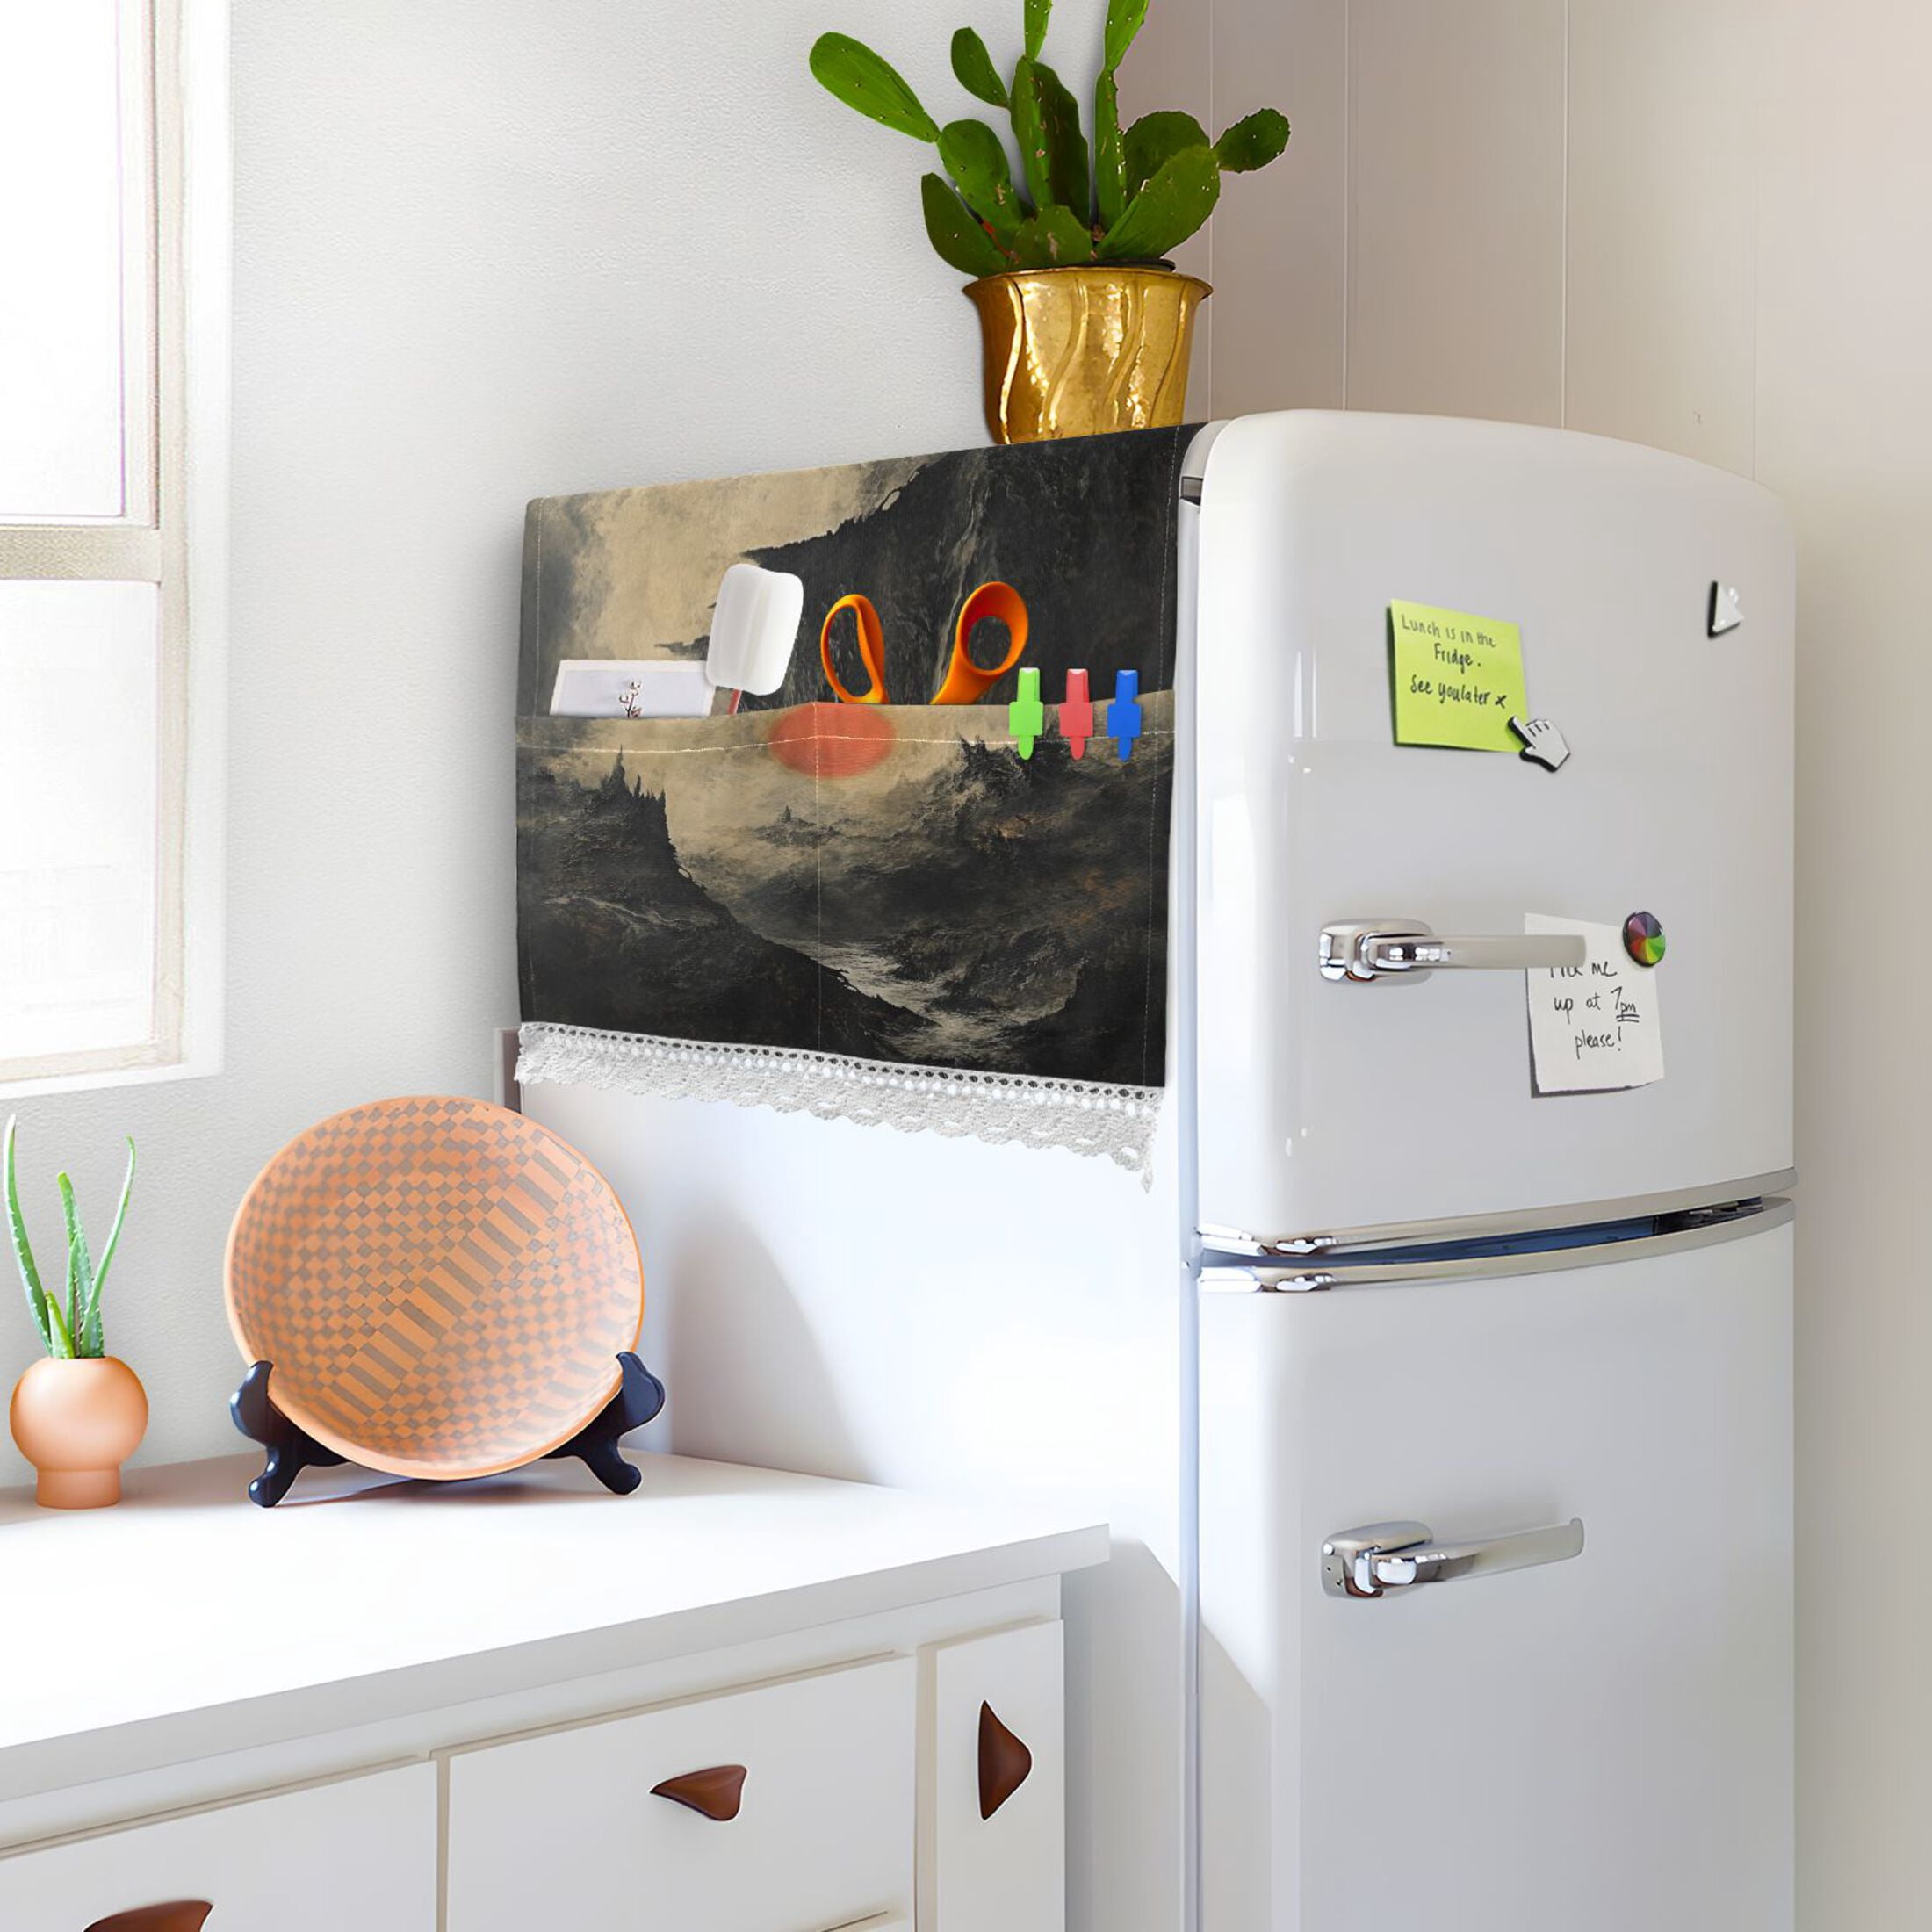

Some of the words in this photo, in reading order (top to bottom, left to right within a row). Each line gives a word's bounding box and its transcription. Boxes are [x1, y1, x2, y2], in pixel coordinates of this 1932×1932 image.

[1402, 614, 1440, 638] Lunch
[1460, 631, 1473, 644] in
[1476, 631, 1496, 647] the
[1410, 674, 1433, 694] See
[1554, 997, 1574, 1025] up
[1586, 991, 1601, 1011] at
[1575, 1026, 1622, 1060] please!
